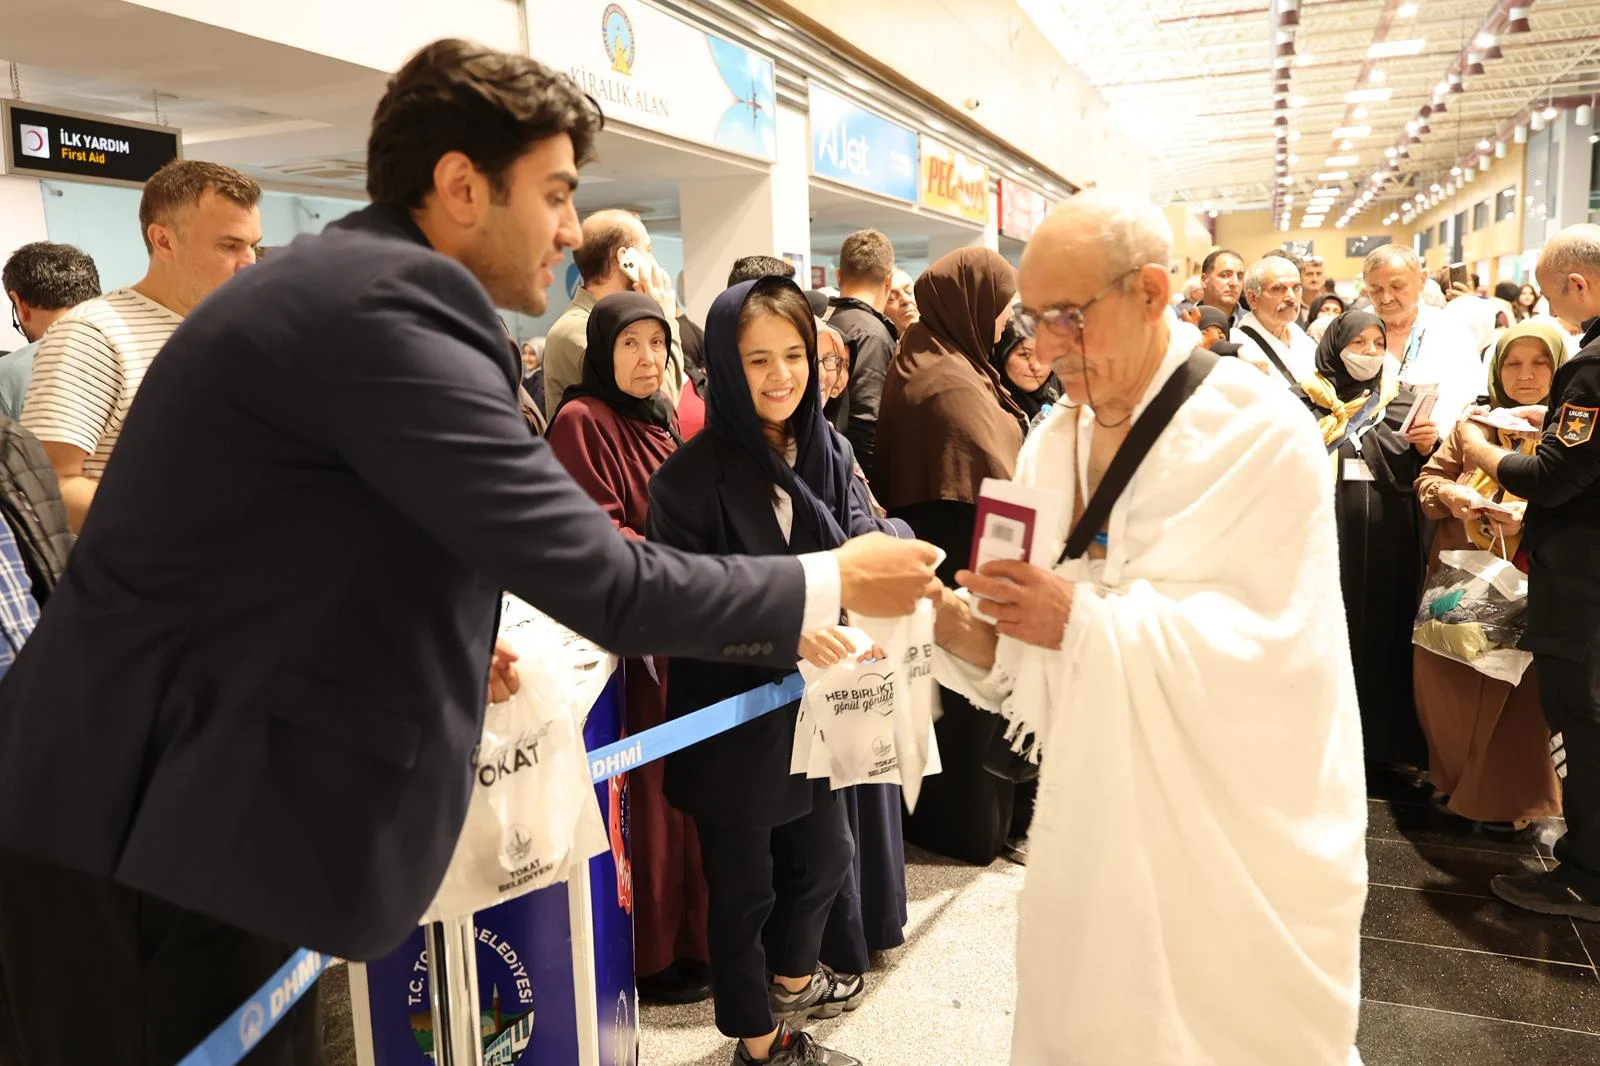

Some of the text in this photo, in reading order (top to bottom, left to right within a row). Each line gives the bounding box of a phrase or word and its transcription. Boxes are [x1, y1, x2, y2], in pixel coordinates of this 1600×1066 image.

[570, 65, 669, 117] KİRALIK ALAN
[60, 128, 130, 154] İLK YARDIM
[61, 147, 105, 164] First Aid
[825, 681, 894, 702] HER BİRLİKT
[478, 742, 540, 787] OKAT
[592, 741, 642, 779] DHMİ
[510, 859, 540, 878] TOKAT
[408, 978, 424, 1006] T.C.
